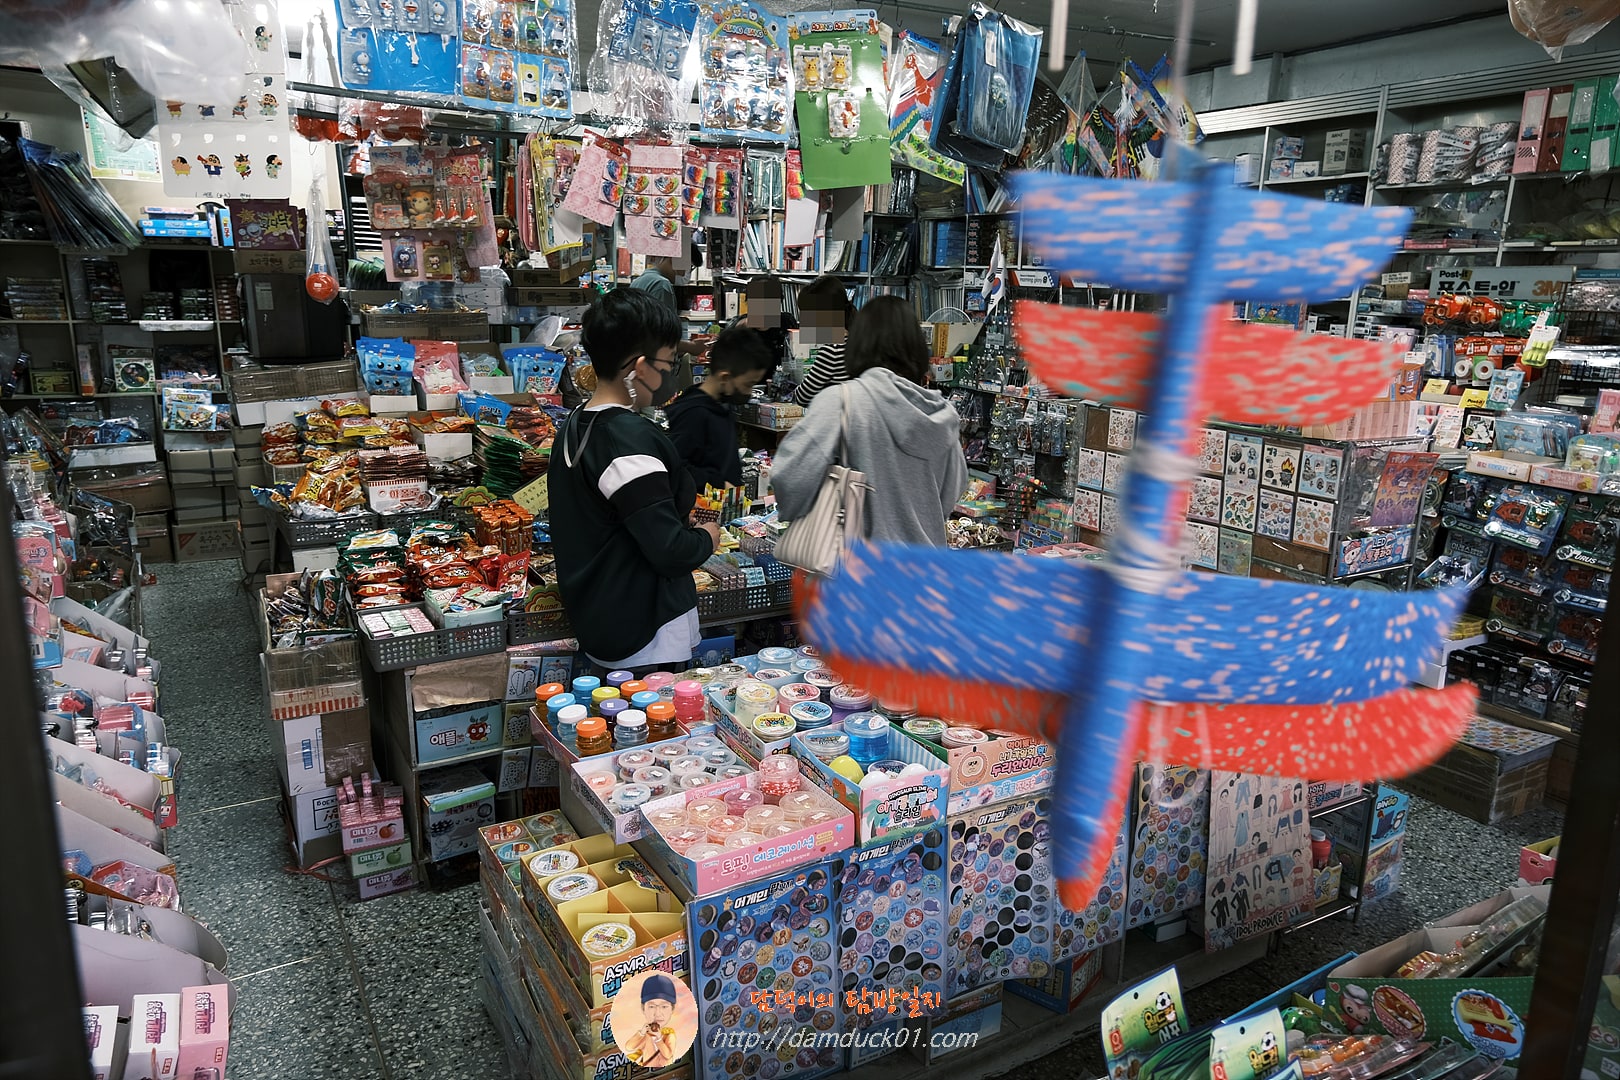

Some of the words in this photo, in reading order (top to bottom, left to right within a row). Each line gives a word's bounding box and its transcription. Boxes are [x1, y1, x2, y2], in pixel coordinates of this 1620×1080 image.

[1440, 270, 1468, 278] Post-it
[721, 853, 750, 875] 토핑
[753, 835, 815, 863] 데코레이션
[857, 844, 890, 863] 어게인
[733, 886, 769, 910] 어게인
[1253, 912, 1284, 932] PRODUCE
[605, 955, 646, 981] ASMR
[598, 1055, 632, 1072] ASM
